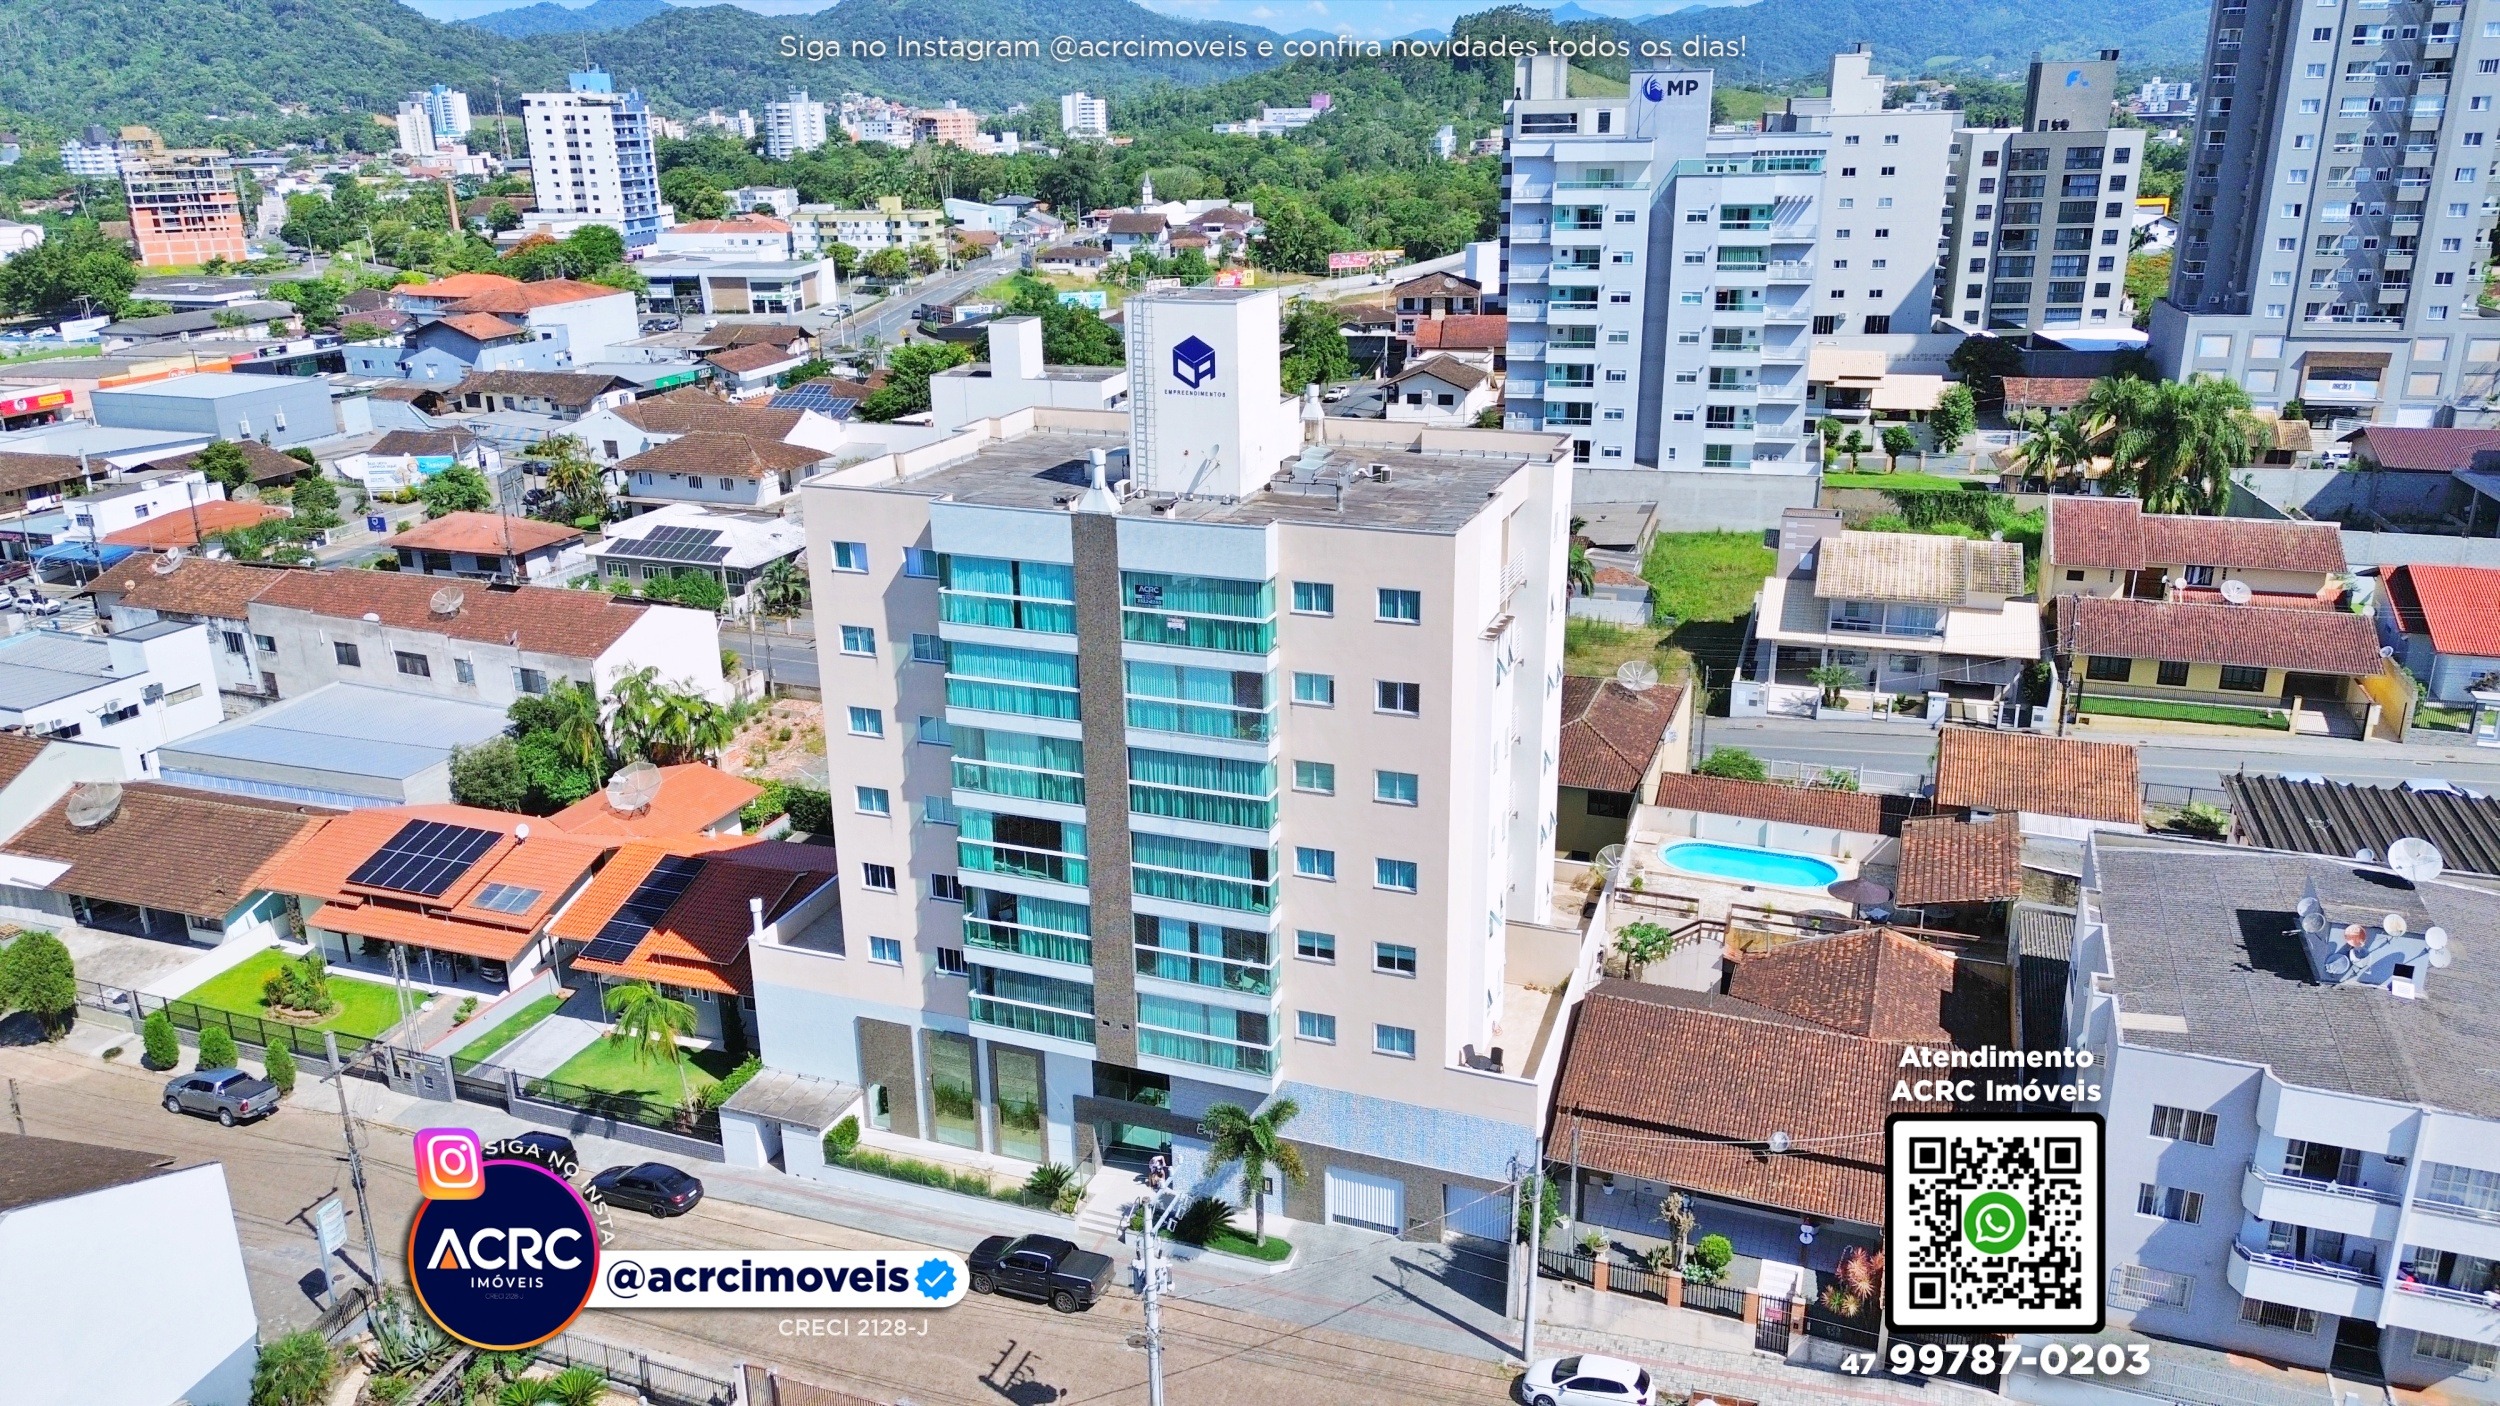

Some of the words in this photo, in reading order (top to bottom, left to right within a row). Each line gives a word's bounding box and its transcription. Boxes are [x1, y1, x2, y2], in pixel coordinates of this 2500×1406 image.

[1667, 79, 1699, 96] MP
[1164, 388, 1226, 398] EMPREENDIMENTOS
[1138, 585, 1160, 594] ACRC
